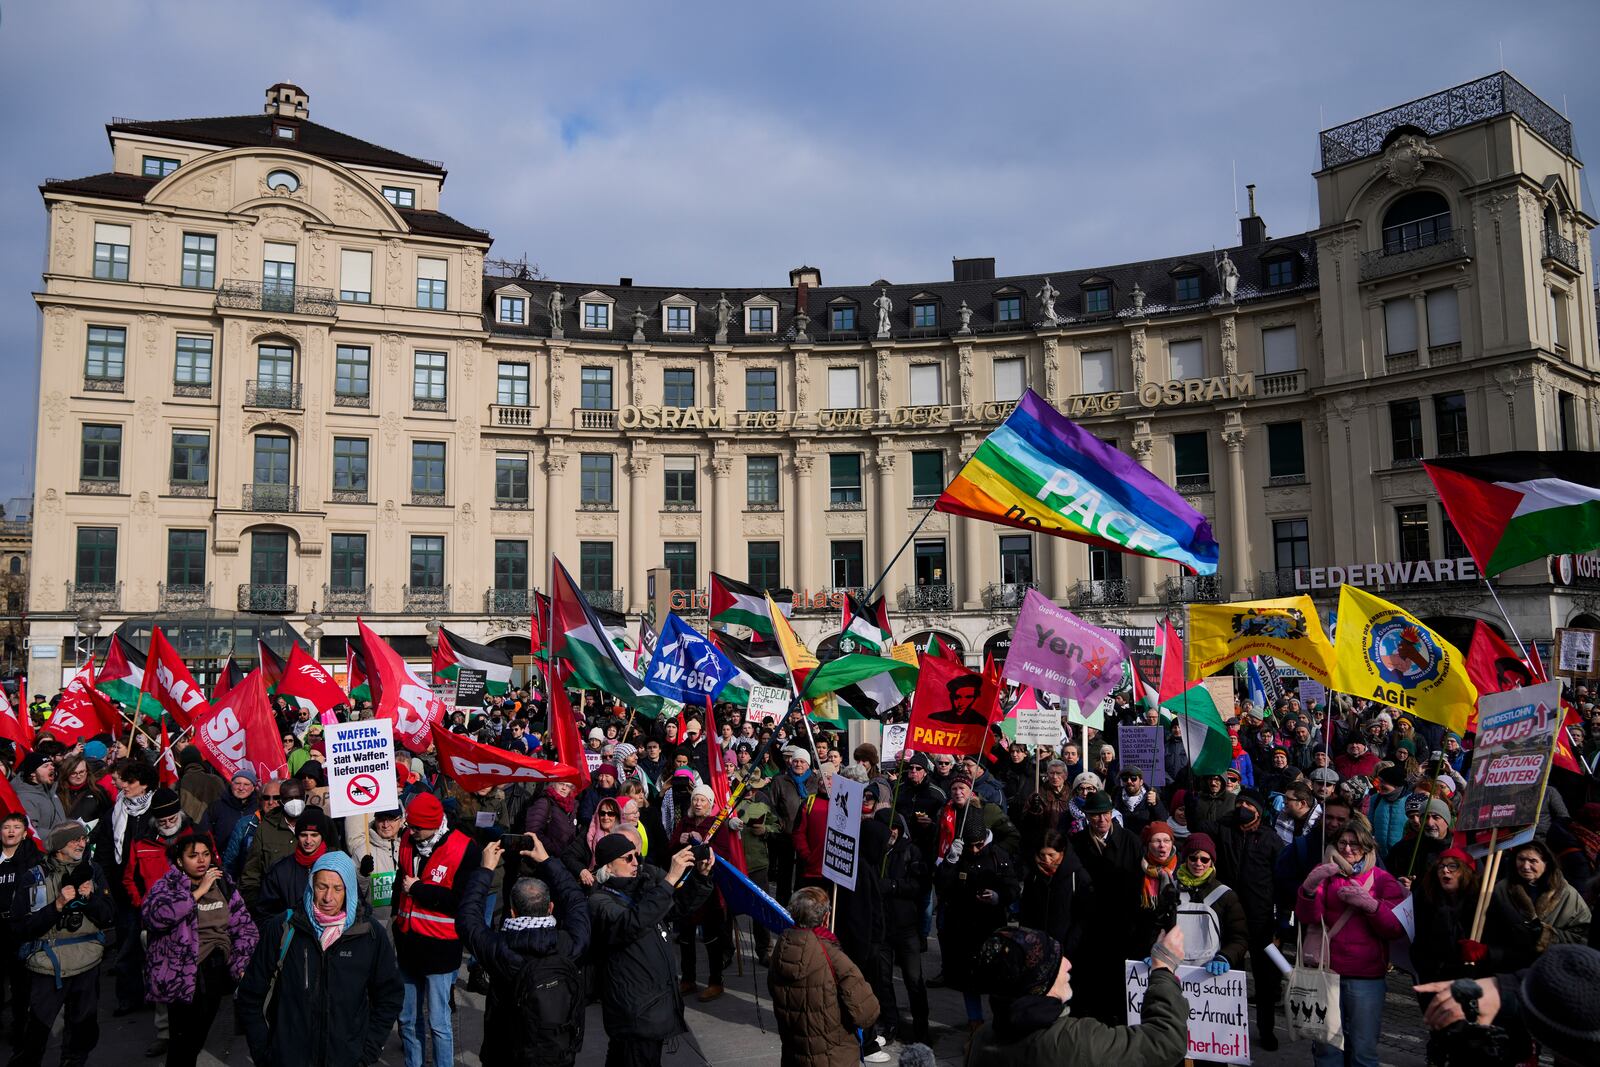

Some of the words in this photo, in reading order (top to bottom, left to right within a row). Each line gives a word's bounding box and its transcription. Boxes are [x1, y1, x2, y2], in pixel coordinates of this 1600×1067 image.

[1138, 371, 1256, 408] OSRAM
[618, 404, 727, 429] OSRAM
[741, 410, 800, 429] HELL
[818, 407, 876, 428] WIE
[891, 404, 950, 426] DER
[1069, 392, 1123, 415] TAG
[1294, 556, 1482, 590] LEDERWARE
[1035, 623, 1084, 663] Yen
[1022, 661, 1043, 676] New
[752, 686, 788, 701] FRIEDEN
[1483, 705, 1533, 728] MINDESTLOHN
[337, 727, 381, 741] WAFFEN-
[1480, 719, 1534, 747] RAUF!
[332, 738, 388, 754] STILLSTAND
[333, 753, 352, 765] statt
[353, 750, 388, 762] Waffen-
[1490, 754, 1543, 770] RÜSTUNG
[334, 761, 389, 777] lieferungen!
[1485, 769, 1538, 785] RUNTER!
[1491, 809, 1515, 818] Kultur
[1203, 977, 1243, 997] schafft
[1187, 1030, 1249, 1058] herheit!
